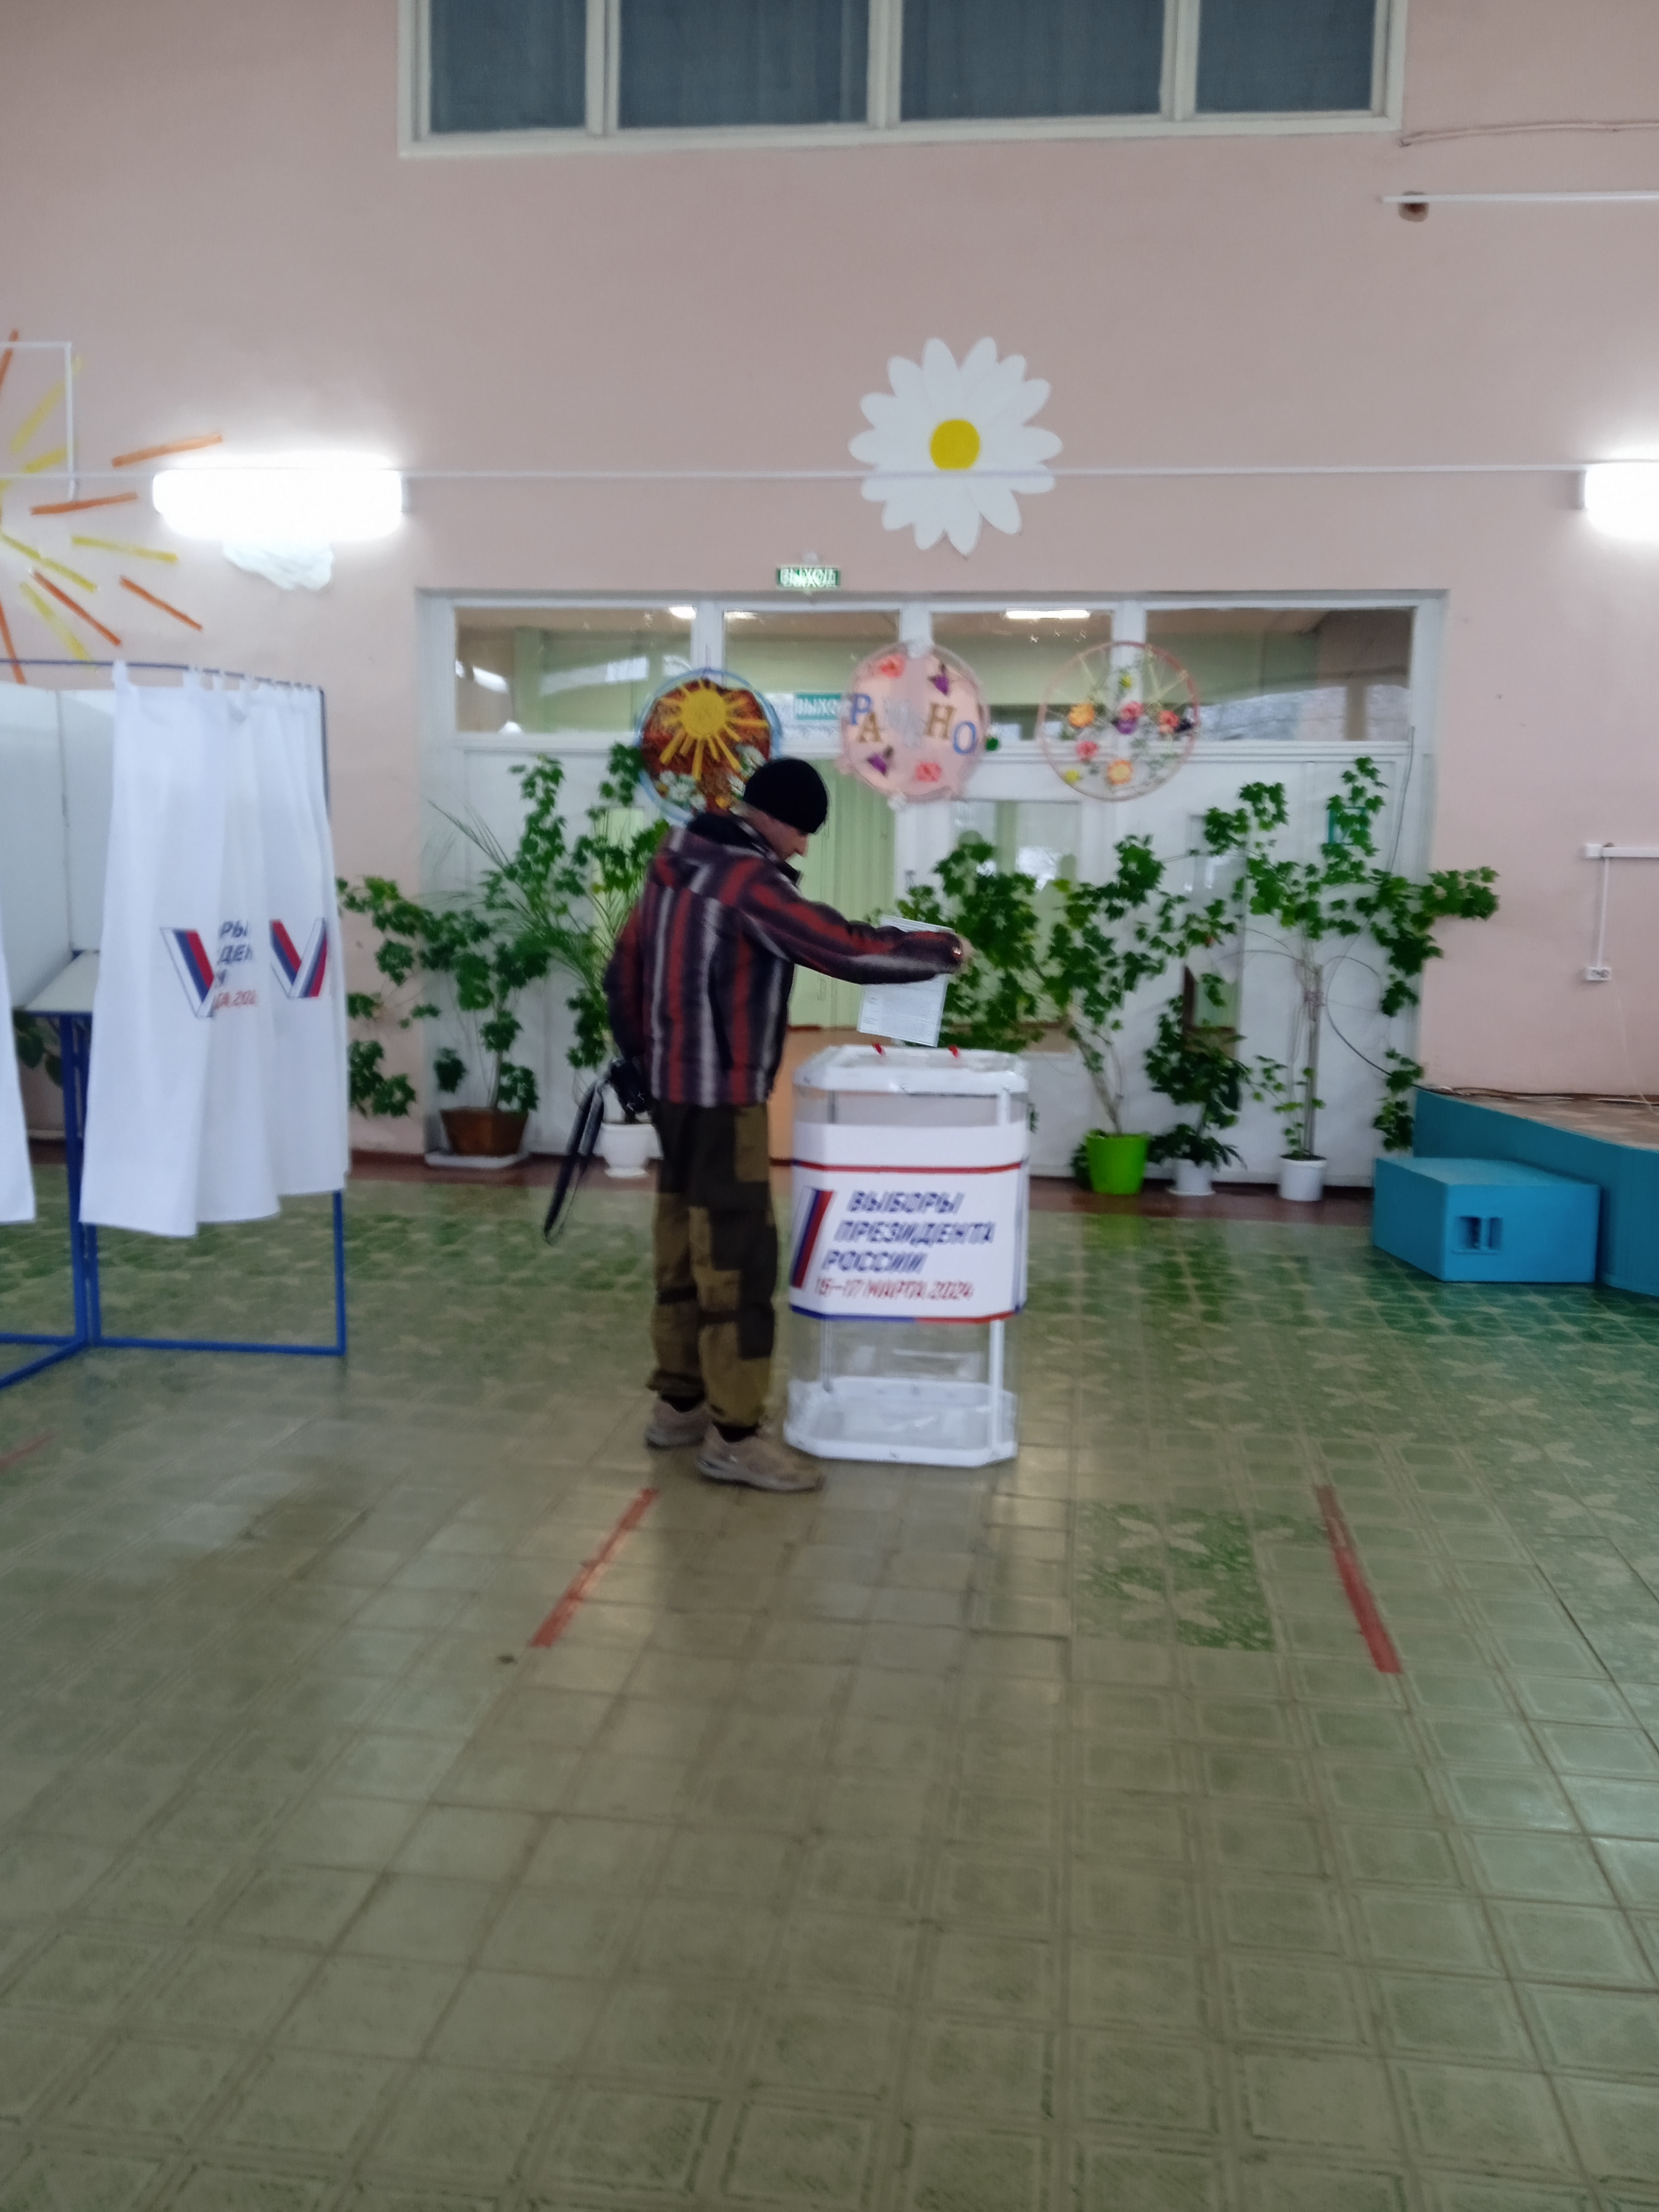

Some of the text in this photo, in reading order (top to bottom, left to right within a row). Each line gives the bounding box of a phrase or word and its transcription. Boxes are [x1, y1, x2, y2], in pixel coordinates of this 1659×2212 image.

[780, 567, 836, 588] ВЫХОД
[795, 698, 839, 716] ВЫХО
[847, 1191, 965, 1214] ВЫБОРЫ
[833, 1220, 996, 1246] ПРЕЗИДЕНТА
[822, 1250, 928, 1274] РОССИИ
[864, 1278, 927, 1300] МАРТА
[928, 1280, 974, 1300] 2024
